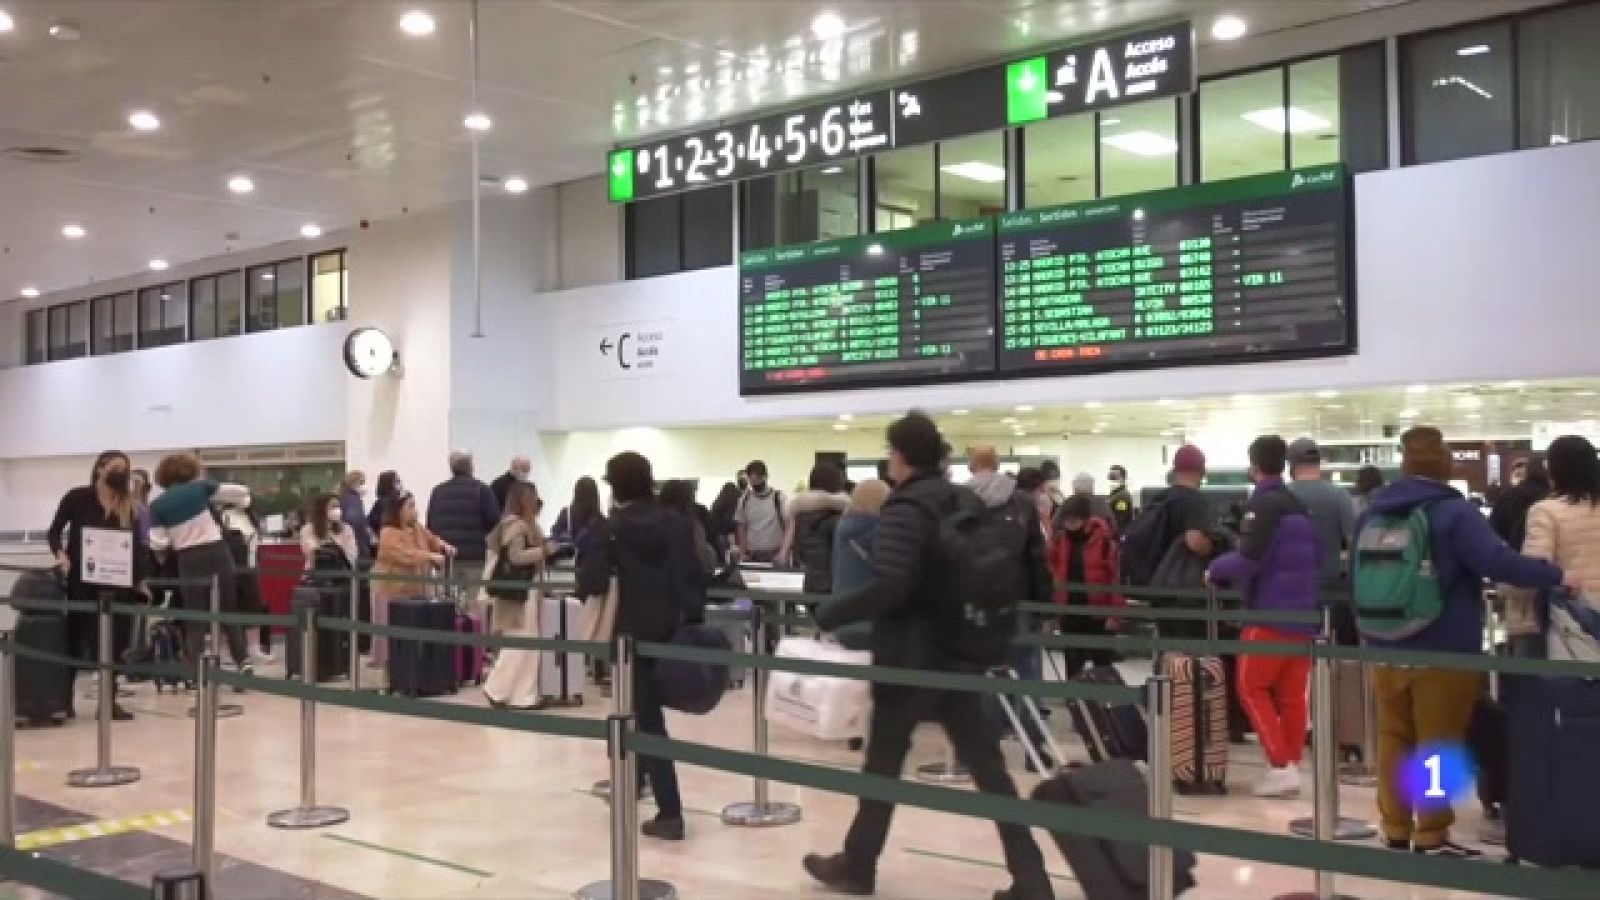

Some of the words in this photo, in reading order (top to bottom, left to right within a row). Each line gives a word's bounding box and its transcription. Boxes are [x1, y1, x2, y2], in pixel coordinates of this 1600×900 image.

[1125, 35, 1175, 58] Acceso
[1085, 47, 1119, 104] A
[617, 331, 631, 371] C
